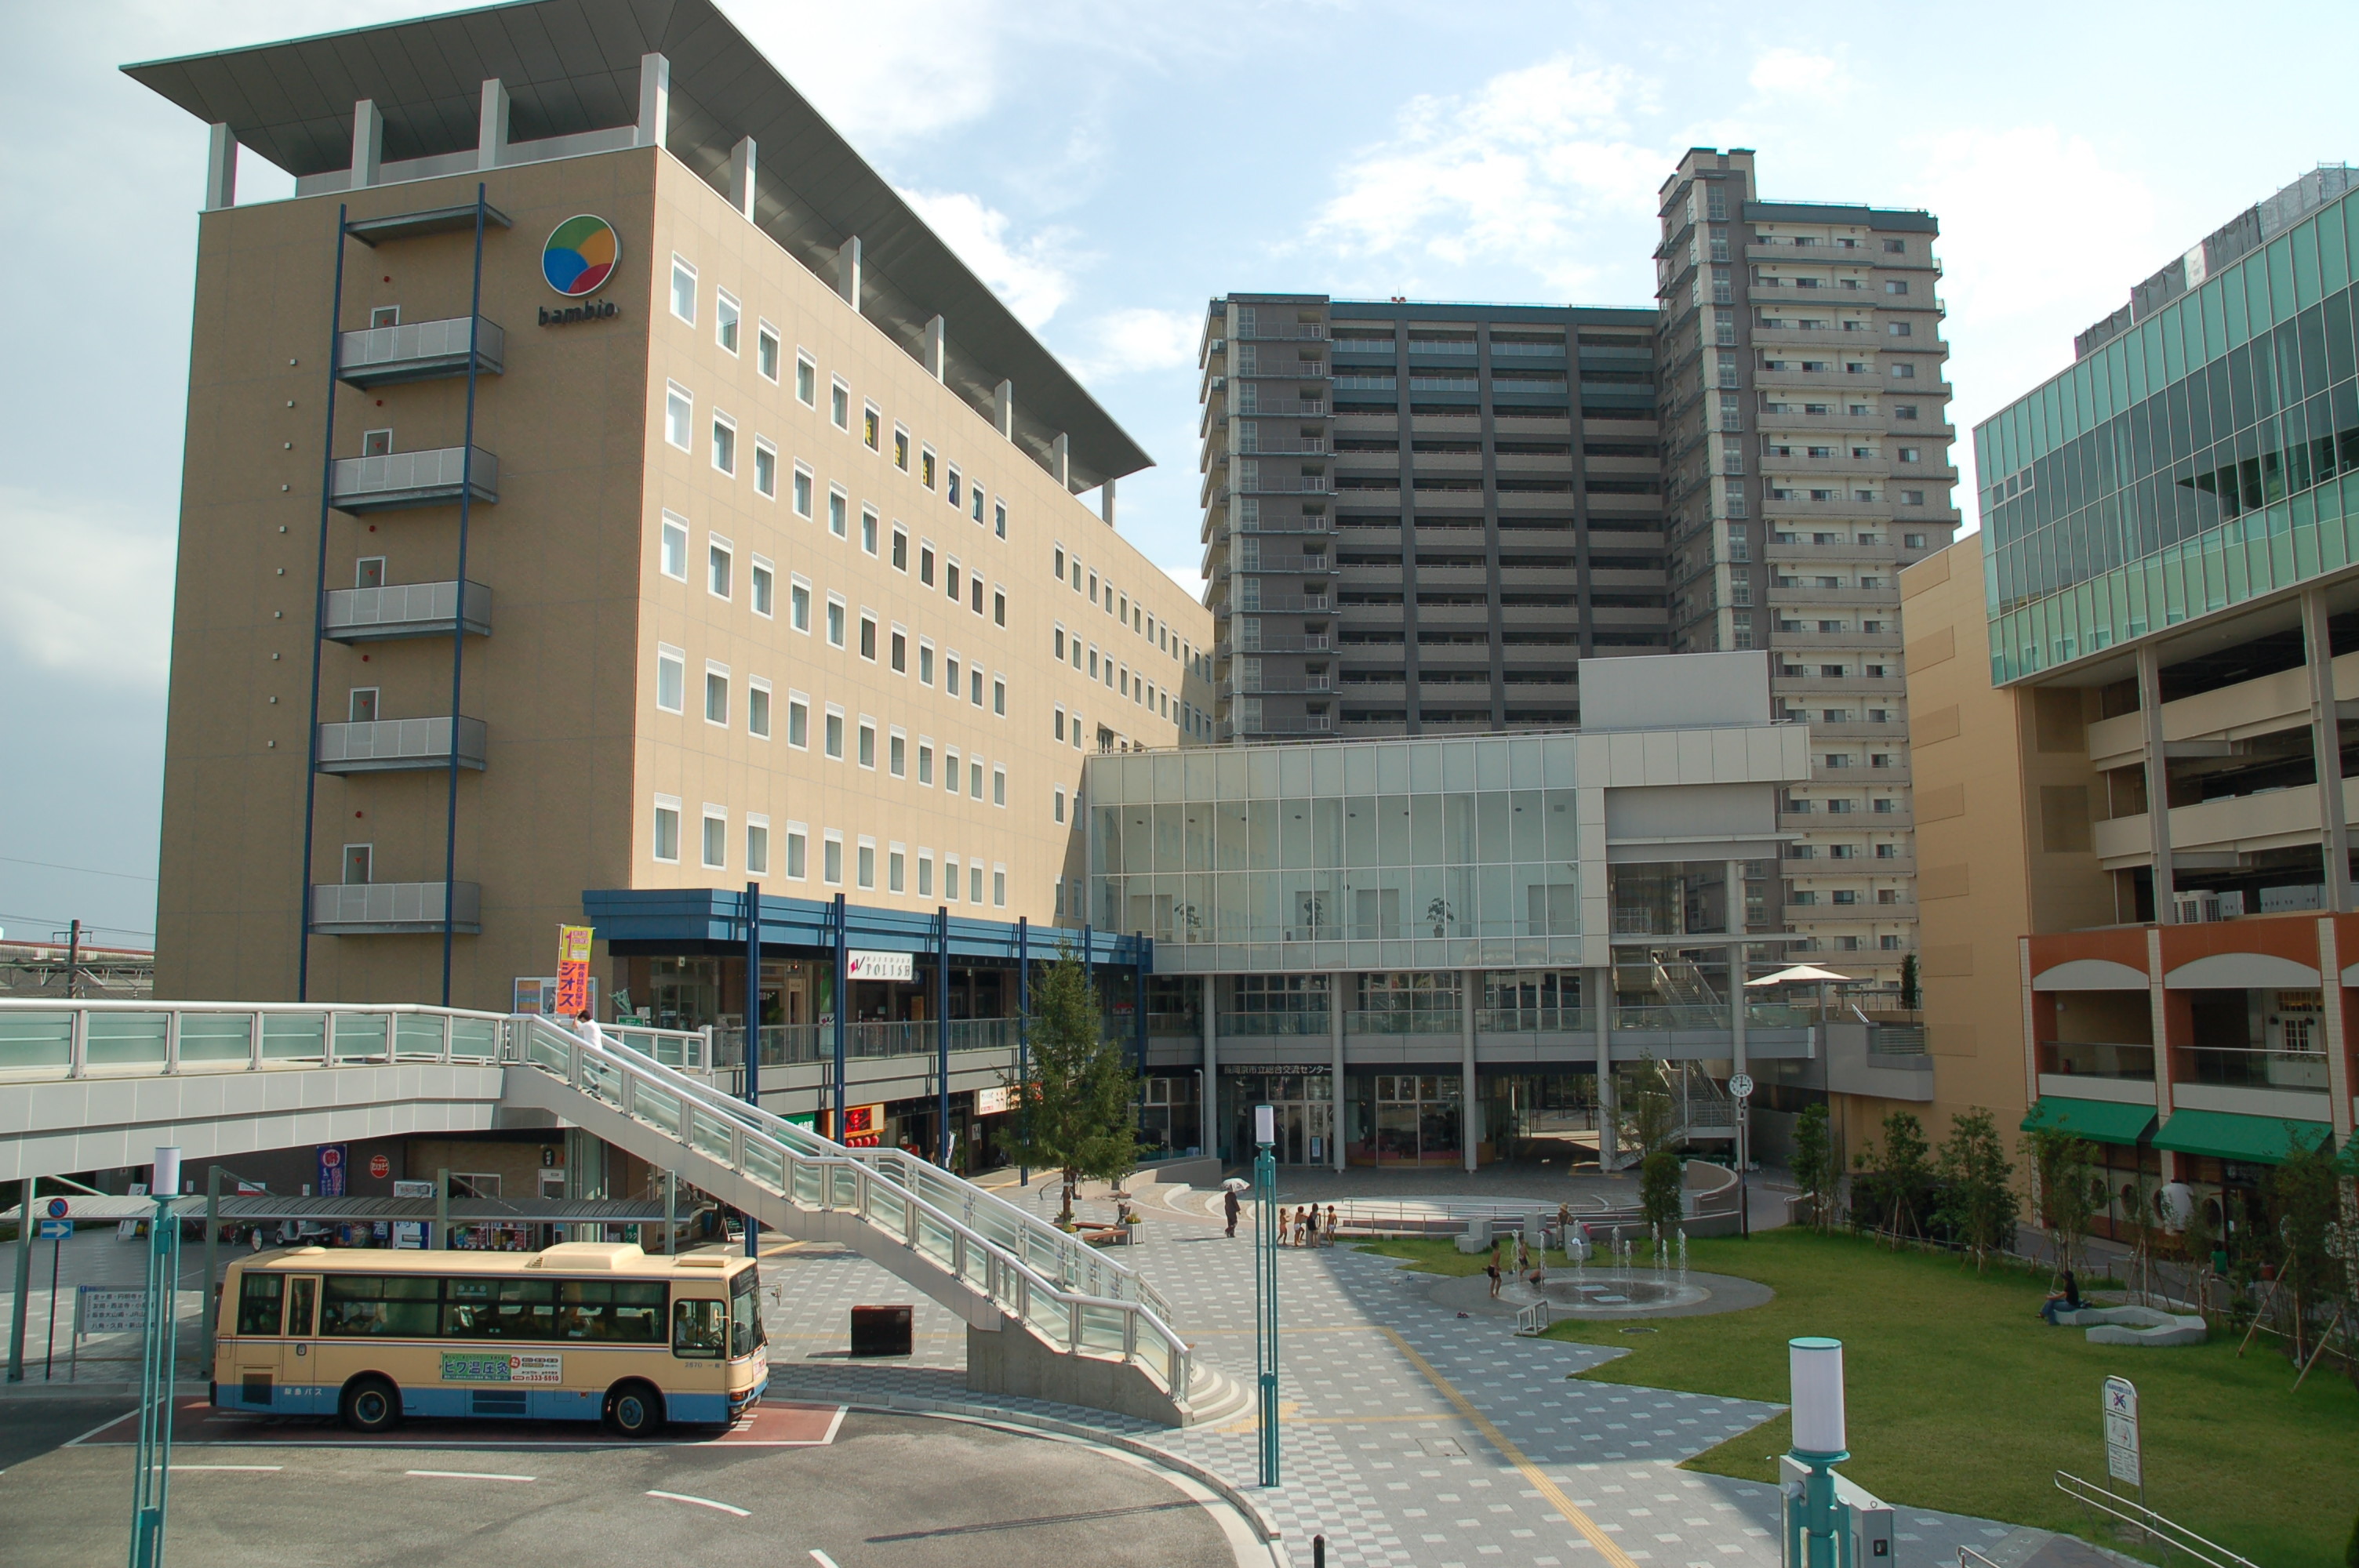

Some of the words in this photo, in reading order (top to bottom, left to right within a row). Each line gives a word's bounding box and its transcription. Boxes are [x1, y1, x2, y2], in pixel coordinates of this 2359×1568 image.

[538, 299, 616, 326] bambio
[866, 964, 910, 978] POLISH
[559, 962, 577, 1007] ジオス
[1224, 1065, 1332, 1075] 長岡京市立総合交流センター
